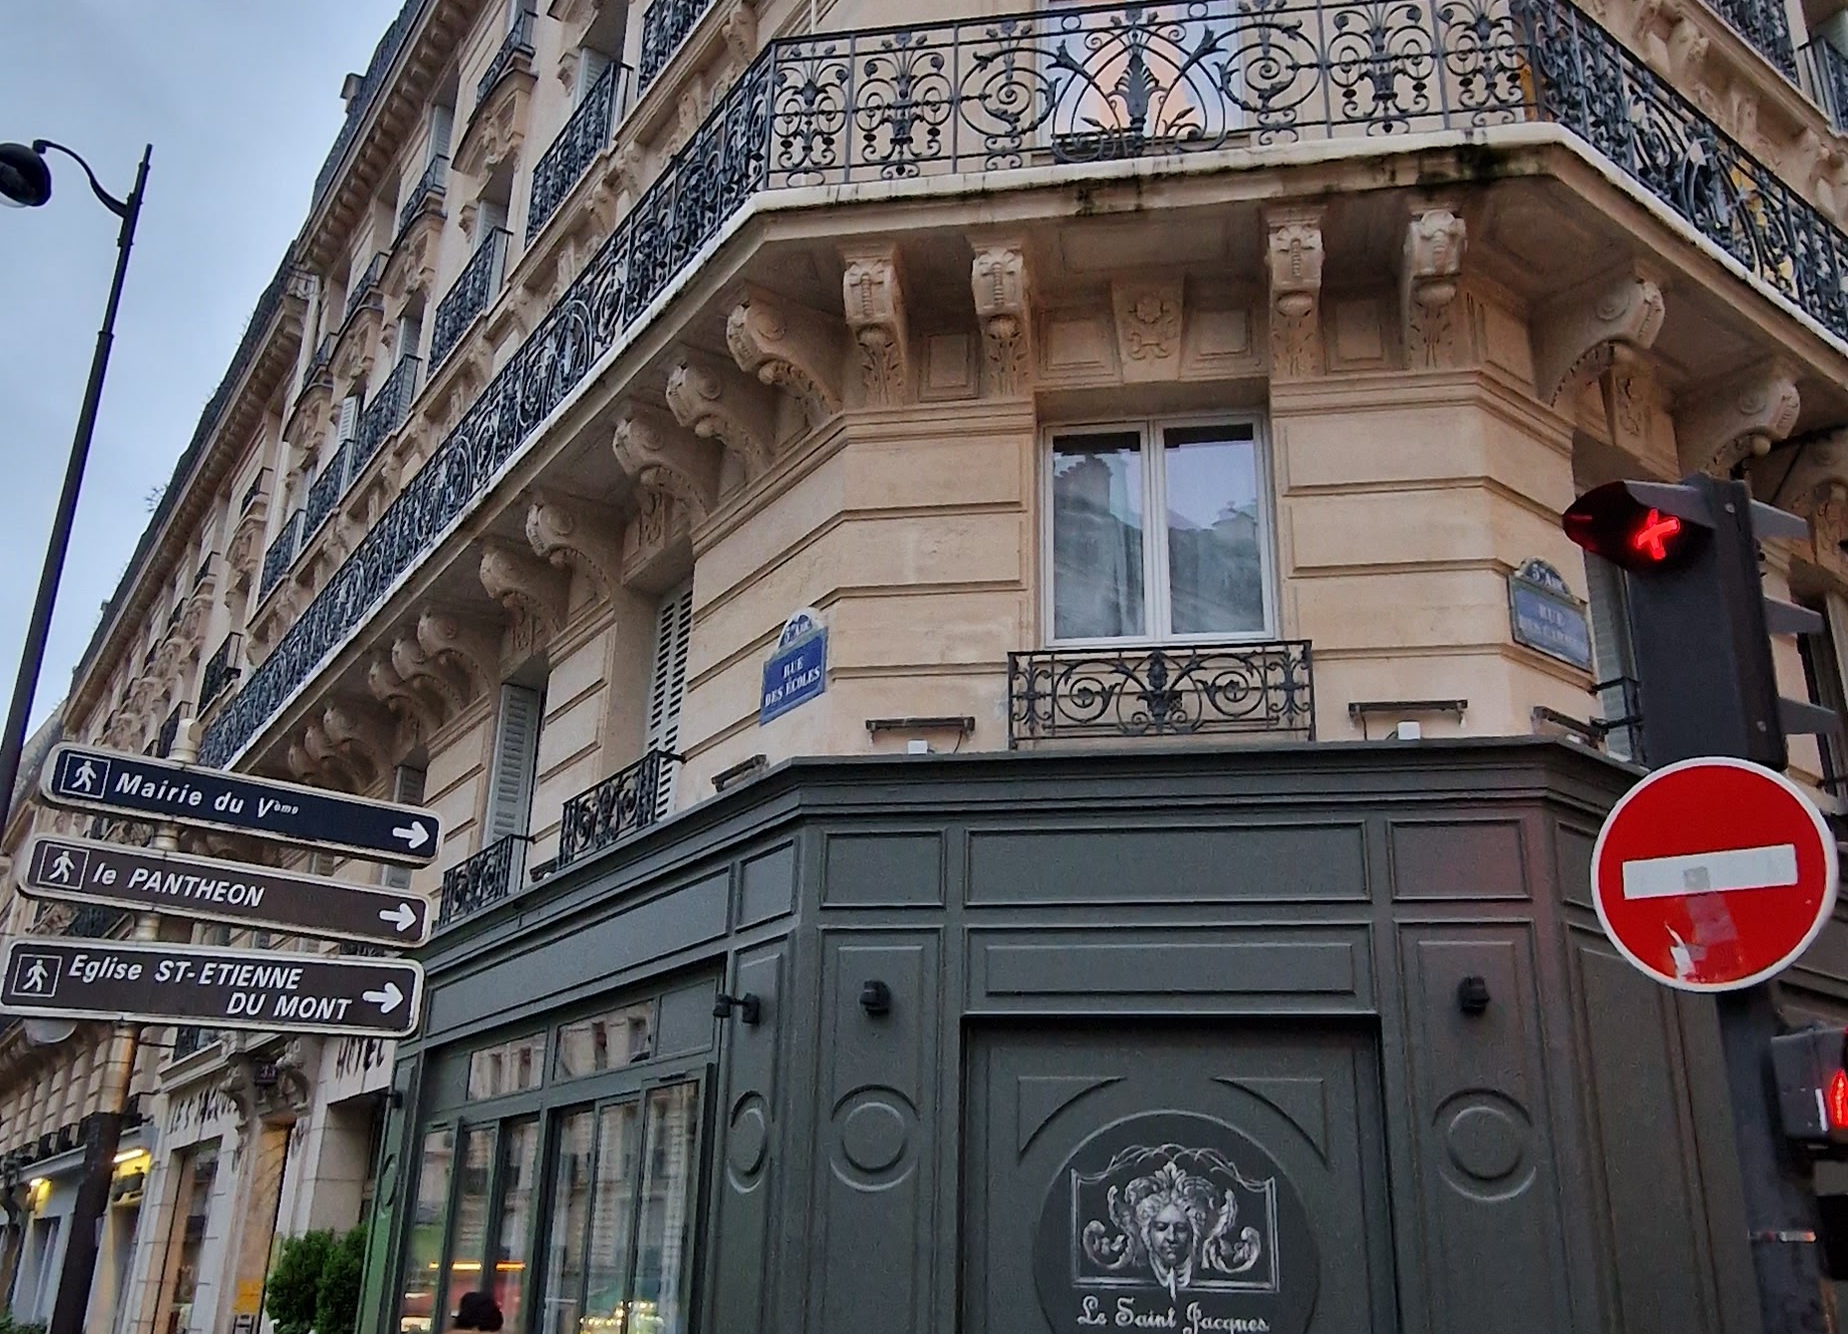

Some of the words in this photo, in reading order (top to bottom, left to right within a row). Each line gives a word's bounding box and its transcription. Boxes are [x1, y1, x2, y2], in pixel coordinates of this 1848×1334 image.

[1539, 604, 1566, 627] RUE
[784, 656, 804, 678] RUE
[765, 686, 783, 707] DES
[114, 772, 203, 807] Mairie
[214, 791, 244, 814] du
[92, 862, 117, 886] le
[128, 868, 265, 908] PANTHEON
[68, 954, 143, 984] Eglise
[154, 960, 303, 992] ST-ETIENNE
[227, 992, 263, 1017] DU
[273, 996, 353, 1022] MONT
[1077, 1296, 1107, 1326] Le
[1115, 1298, 1176, 1328] Saint
